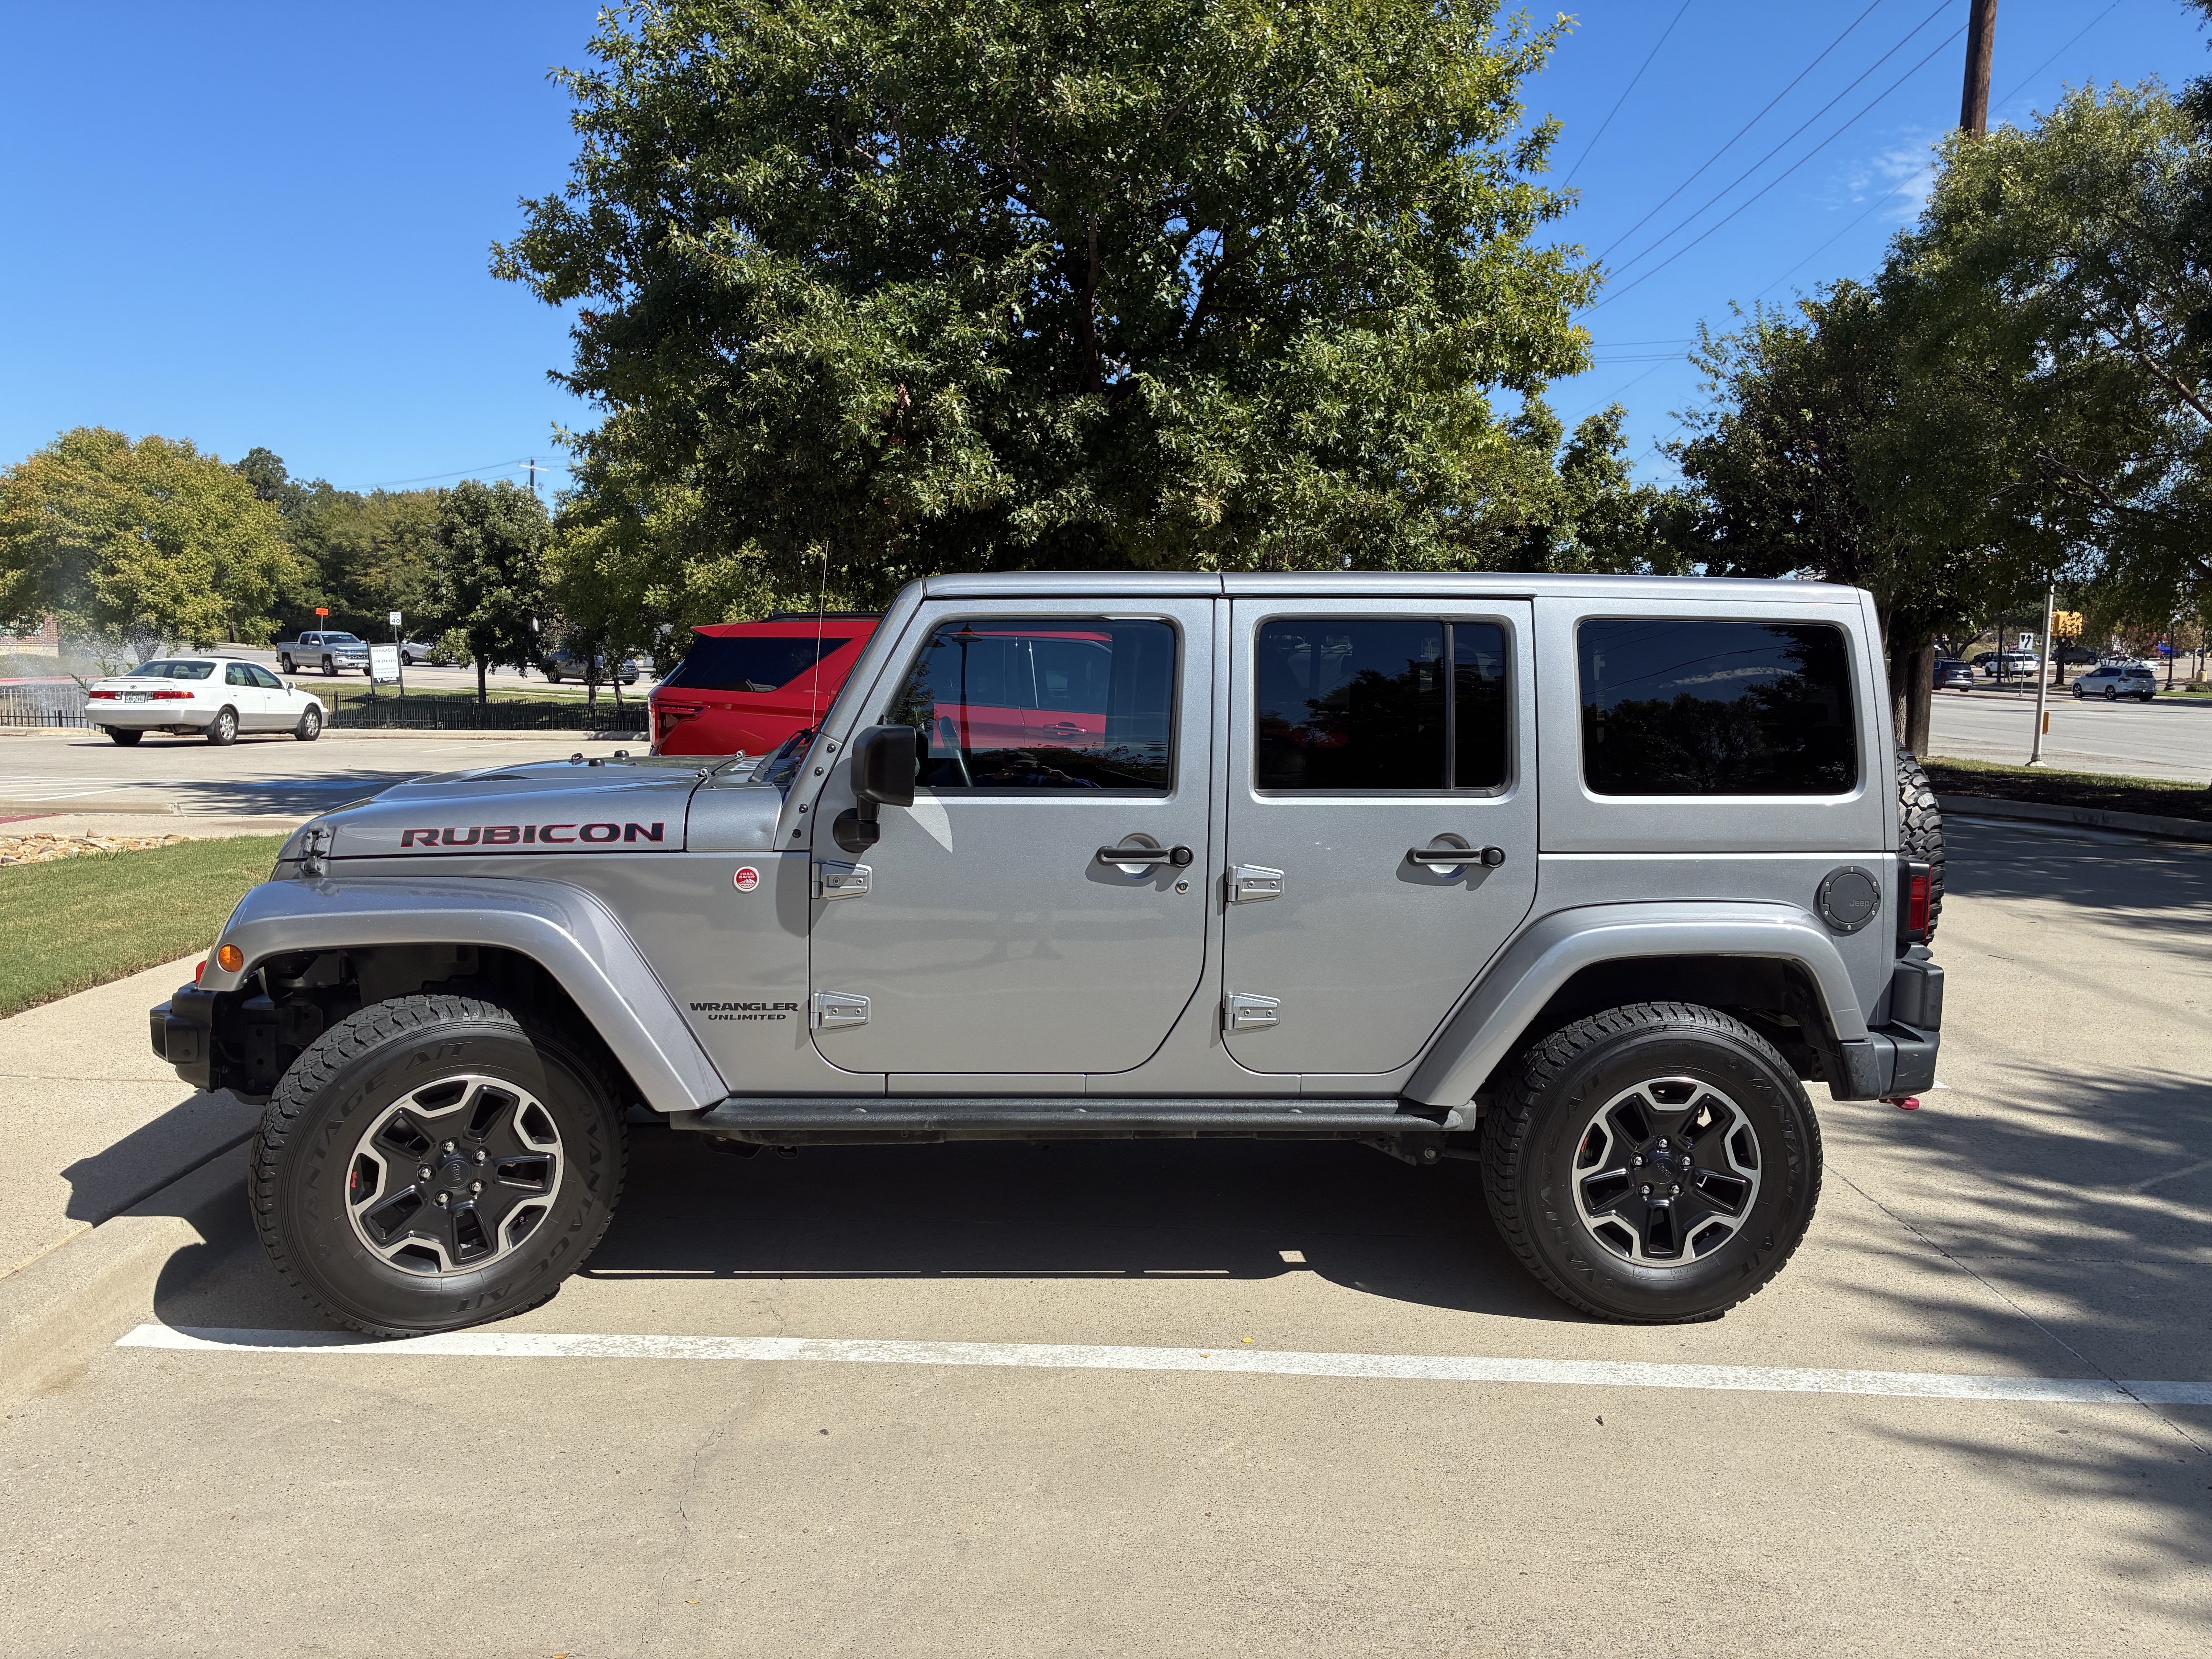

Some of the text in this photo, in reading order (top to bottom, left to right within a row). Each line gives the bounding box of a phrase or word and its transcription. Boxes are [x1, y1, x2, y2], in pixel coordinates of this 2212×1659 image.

[400, 823, 665, 847] RUBICON
[1849, 898, 1870, 908] Jeep
[690, 1003, 799, 1012] WRANGLER
[405, 1041, 472, 1070] A/T
[450, 1163, 462, 1183] Jeep
[1657, 1163, 1672, 1177] Jeep
[448, 1282, 514, 1313] A/T
